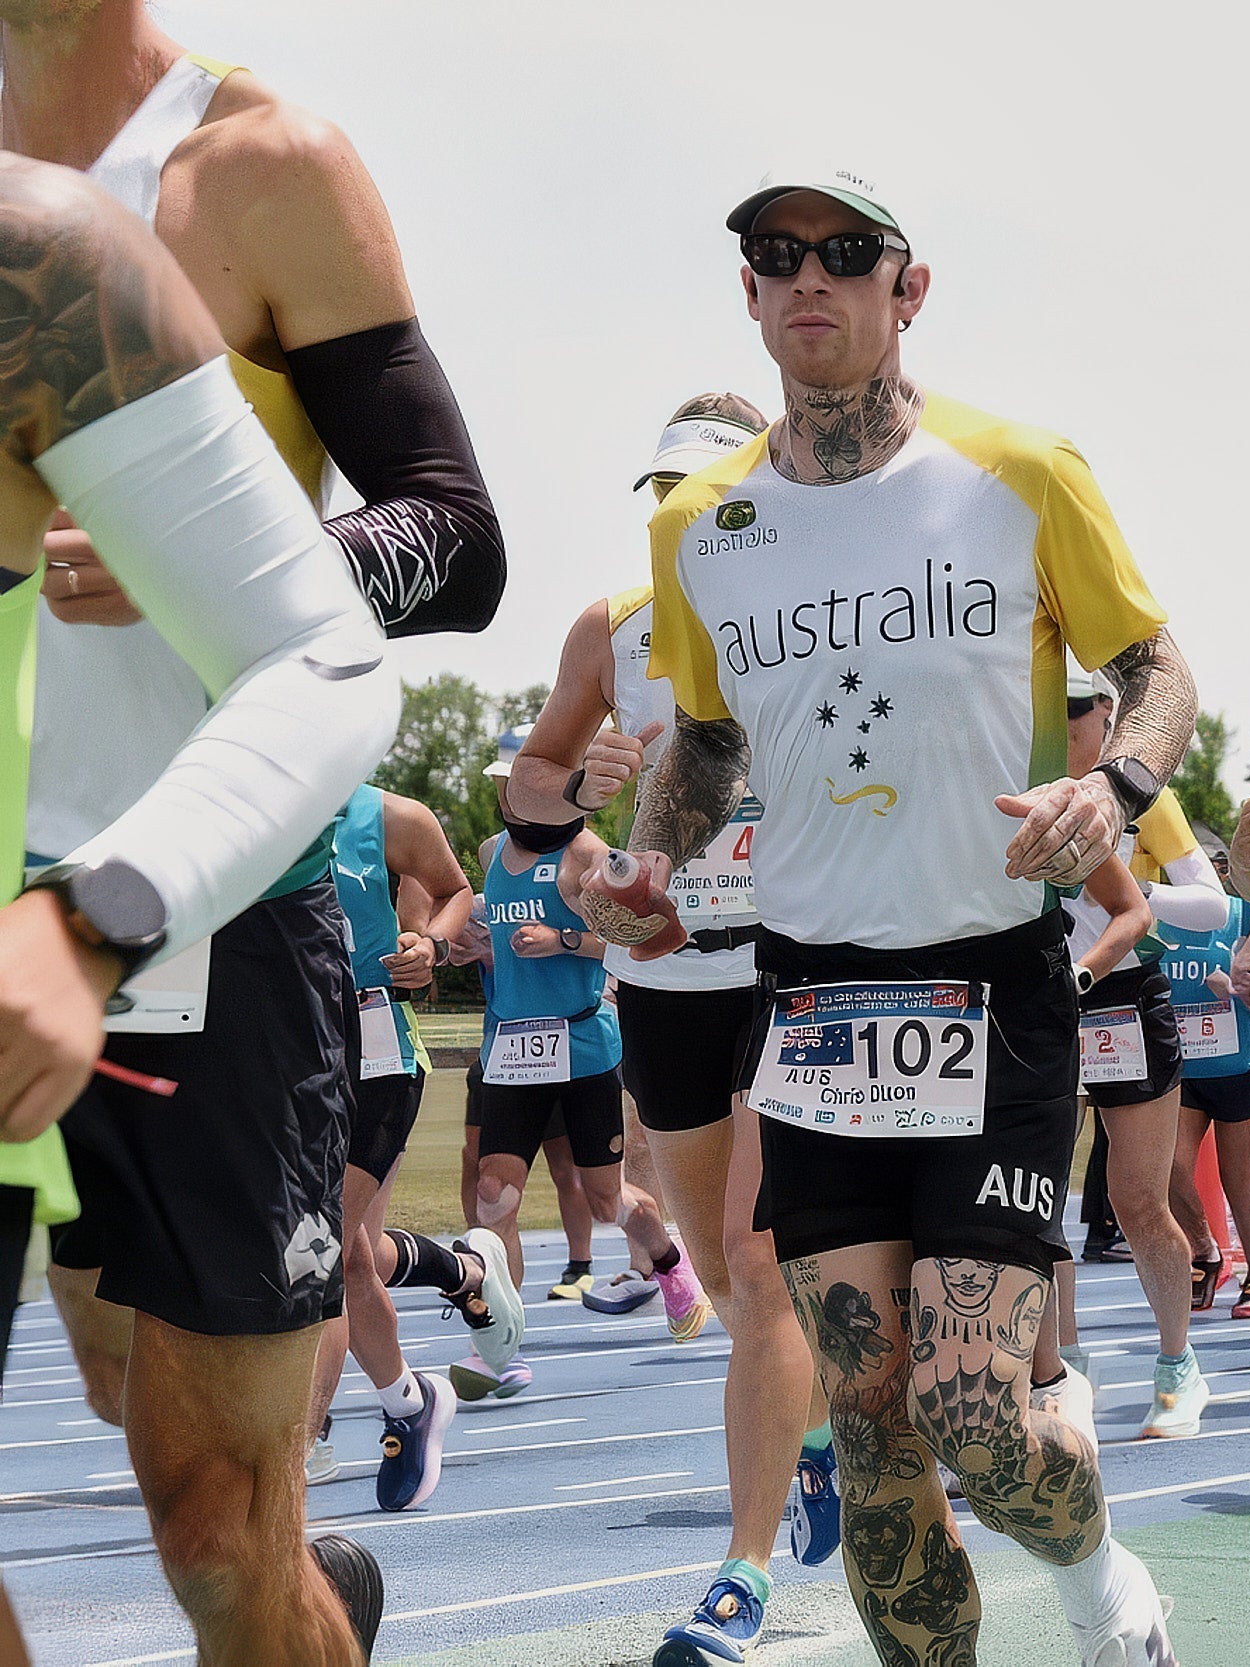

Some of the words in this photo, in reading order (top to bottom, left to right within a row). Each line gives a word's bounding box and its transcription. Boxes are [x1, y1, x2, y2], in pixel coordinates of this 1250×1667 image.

[718, 558, 996, 676] australia
[857, 1019, 975, 1079] 102
[975, 1163, 1054, 1221] AUS
